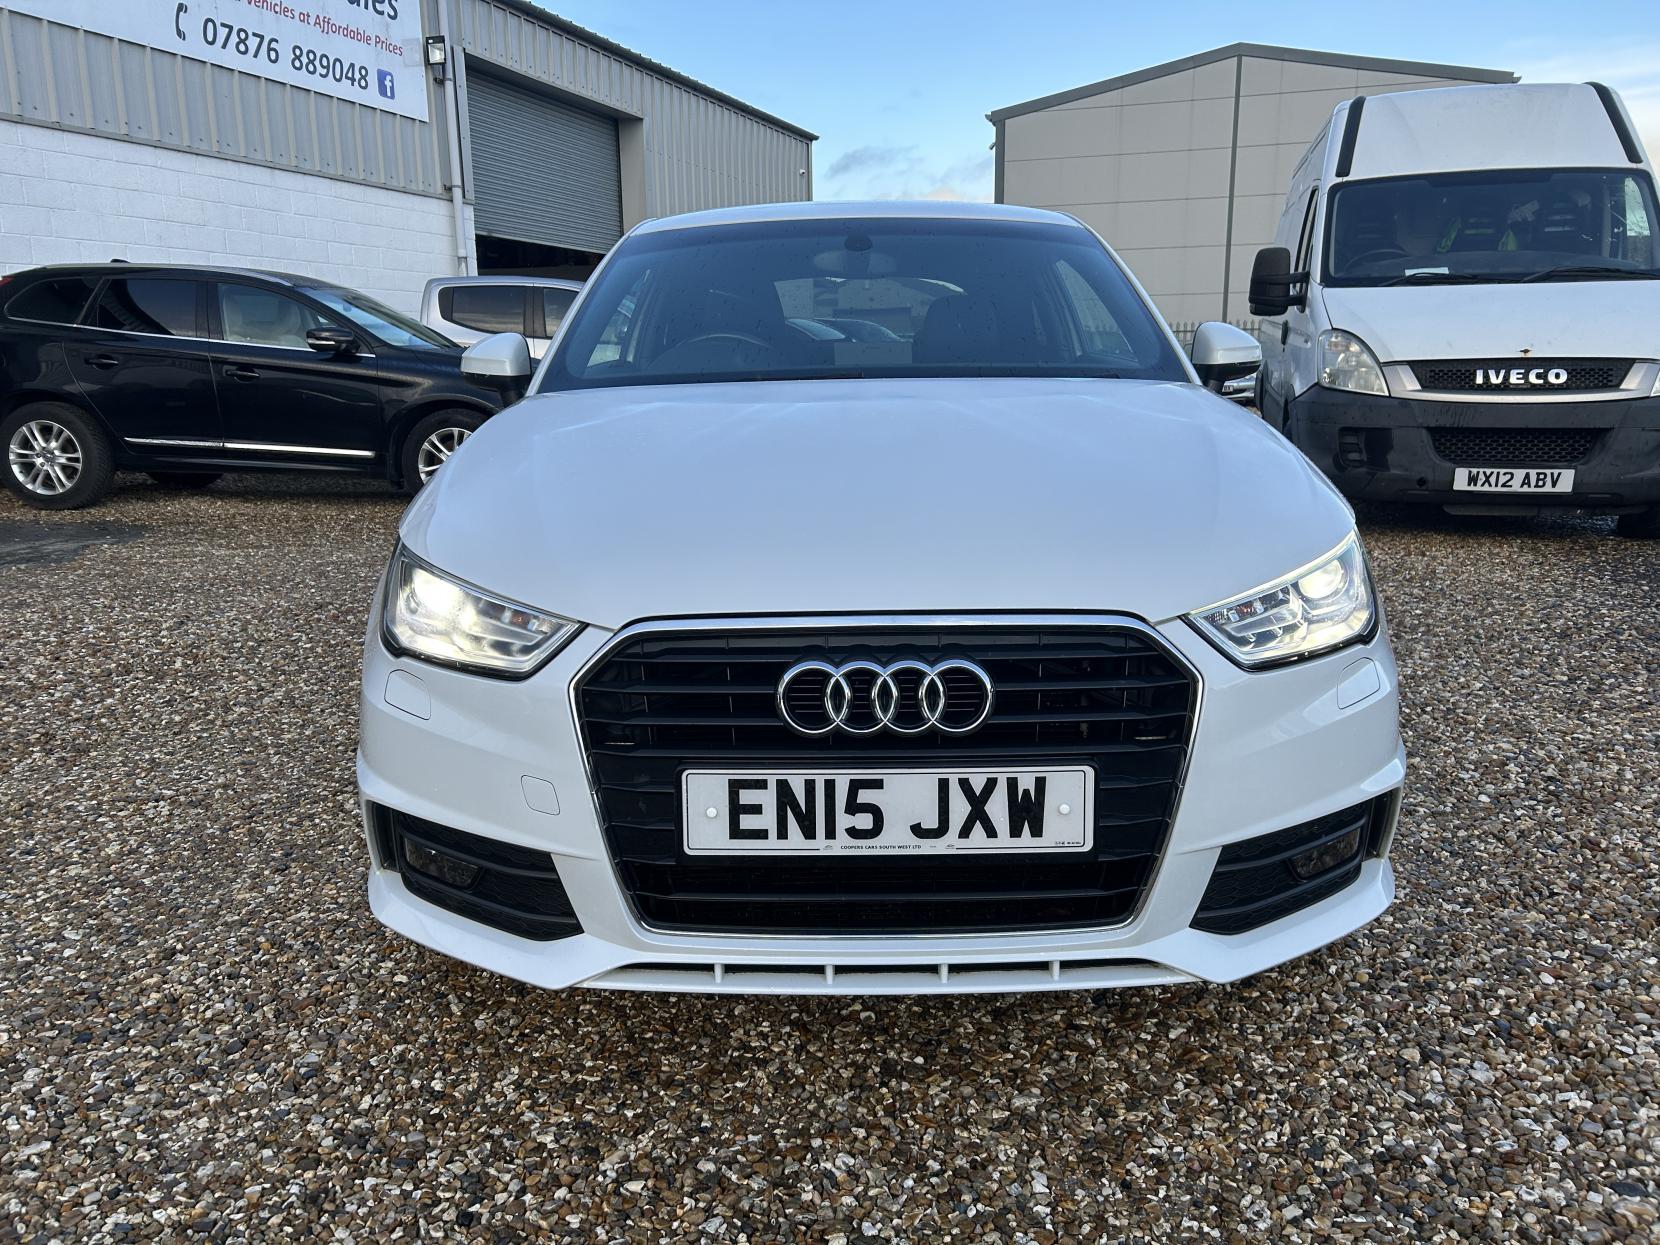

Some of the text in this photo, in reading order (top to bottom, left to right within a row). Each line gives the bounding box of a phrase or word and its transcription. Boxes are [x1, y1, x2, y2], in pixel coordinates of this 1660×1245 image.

[202, 17, 370, 90] 07876 889048
[299, 11, 311, 25] at
[313, 14, 372, 46] Affordable
[374, 35, 403, 57] Prices
[1475, 368, 1568, 385] IVECO
[1467, 469, 1562, 489] WX12 ABV
[728, 776, 1047, 841] EN15 JXW
